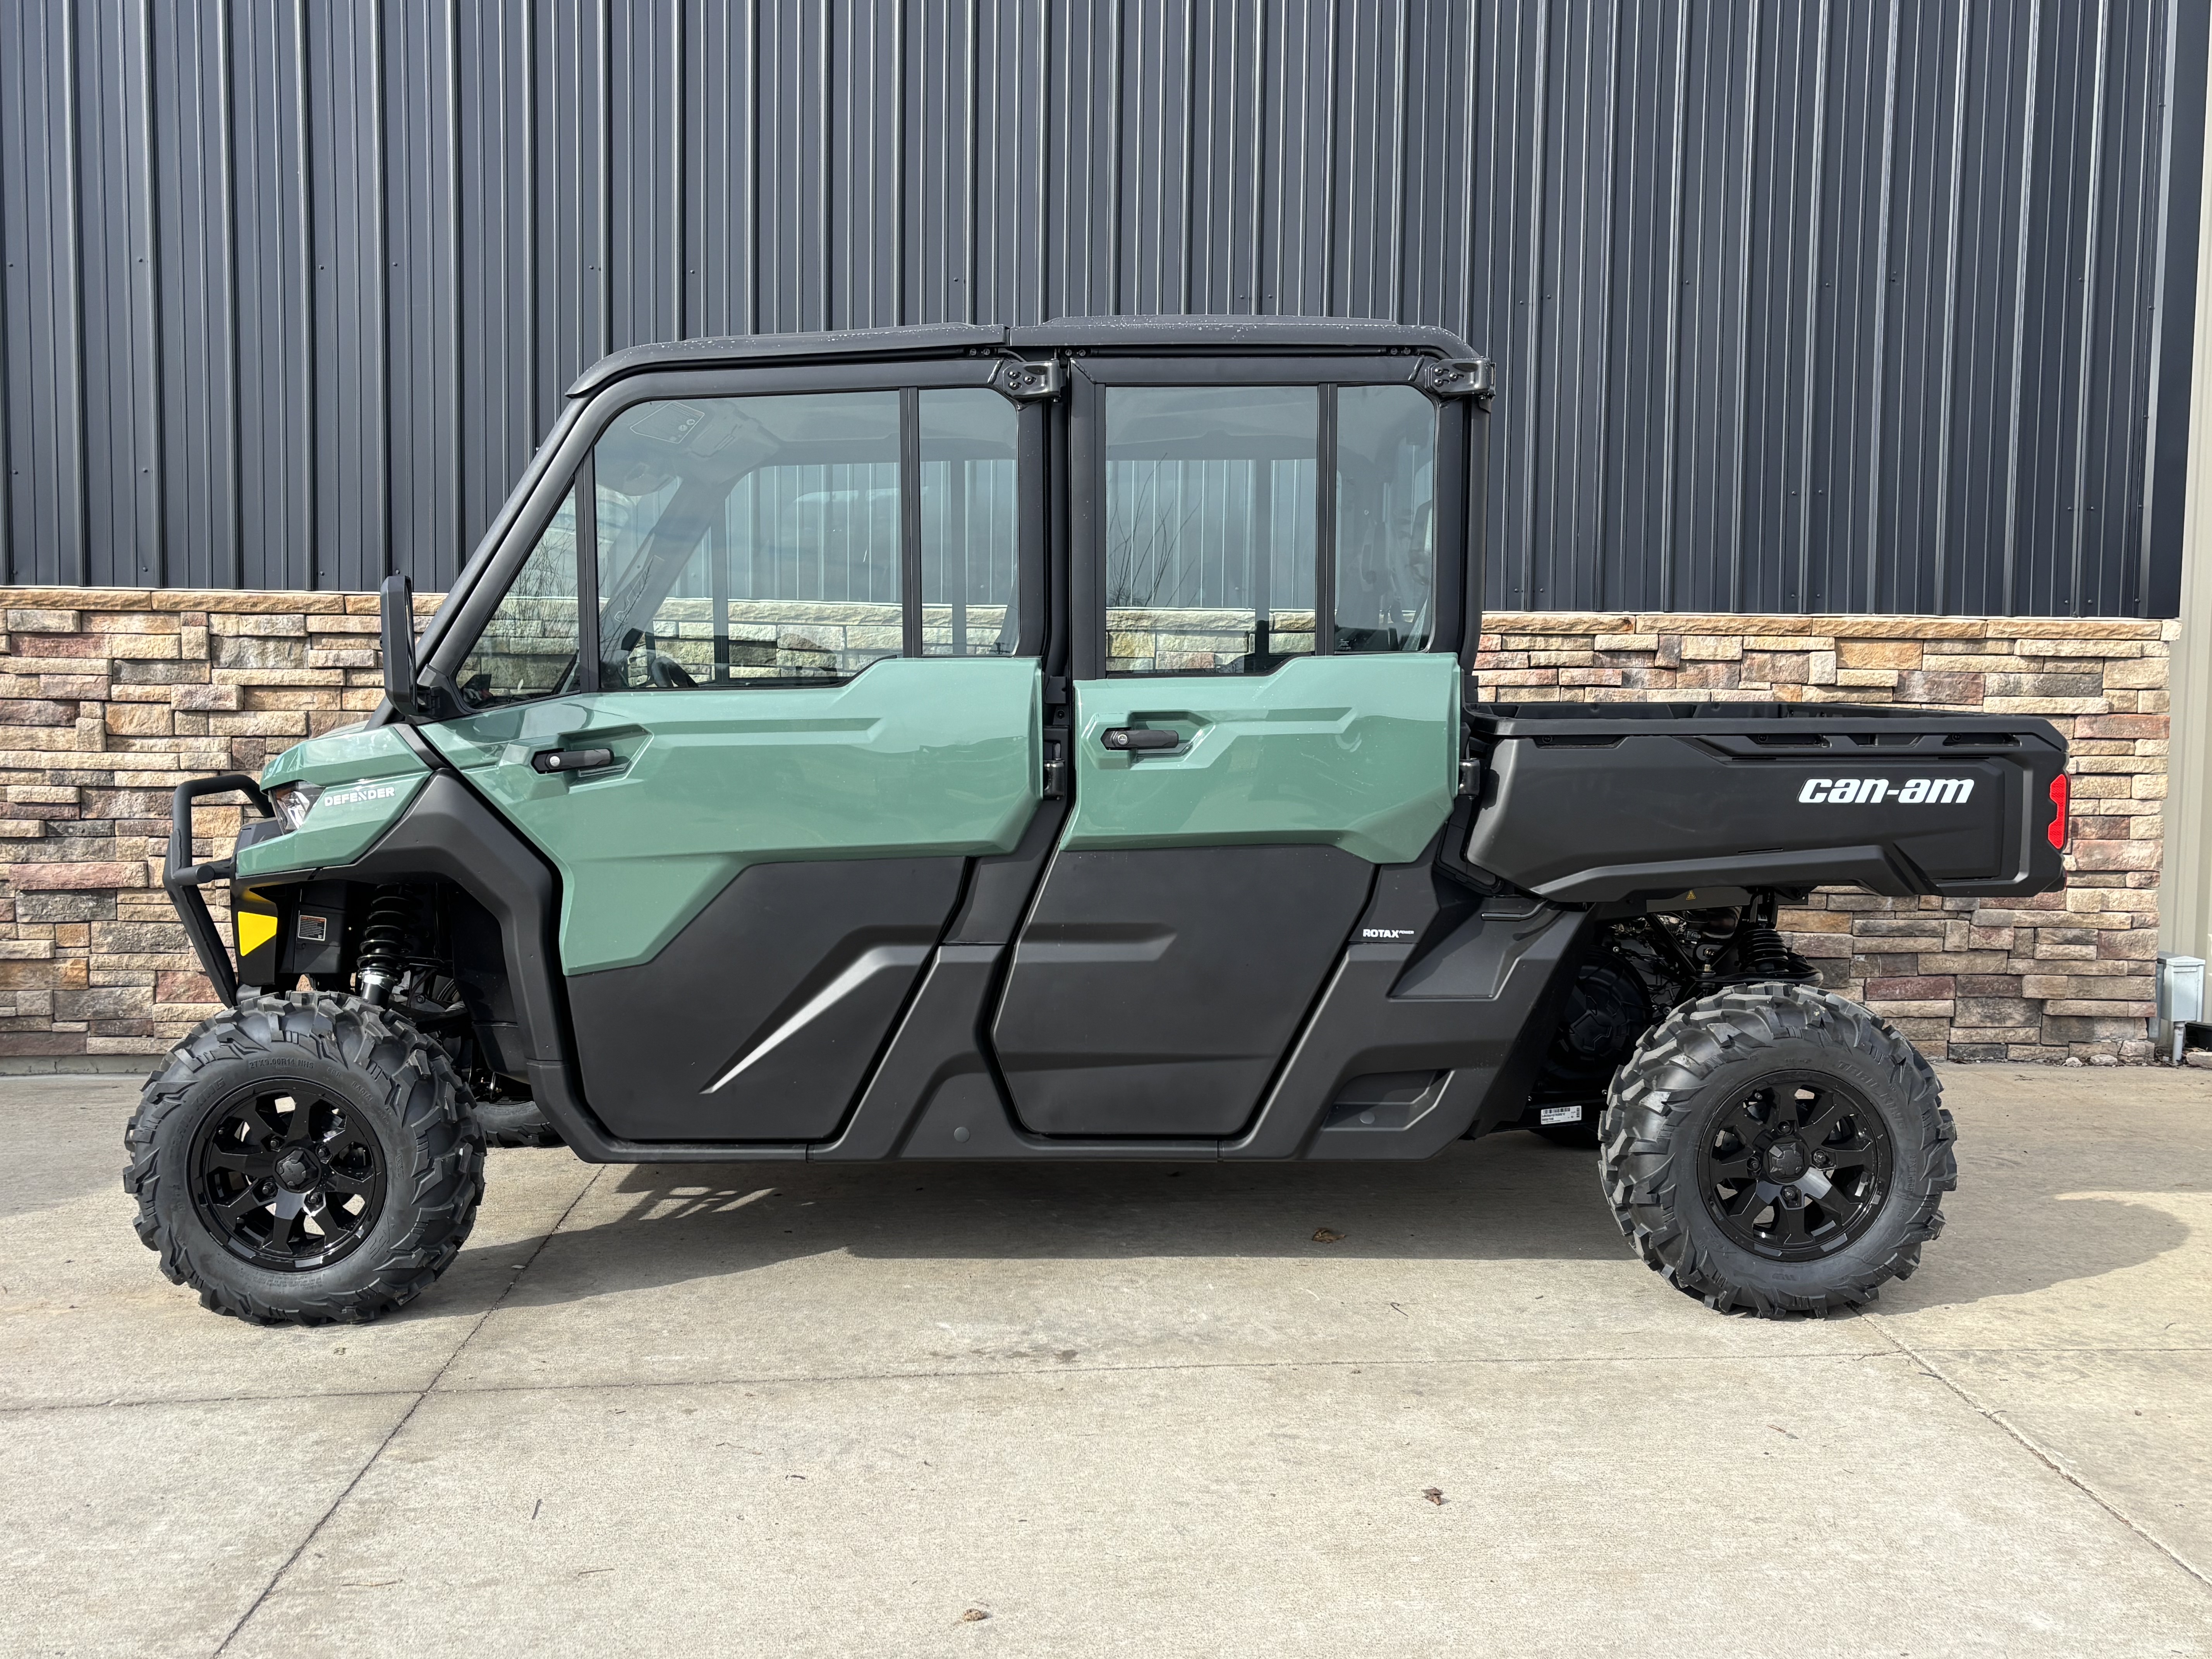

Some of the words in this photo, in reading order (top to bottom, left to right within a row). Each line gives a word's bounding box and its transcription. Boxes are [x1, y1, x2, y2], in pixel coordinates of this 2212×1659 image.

[324, 787, 395, 807] DEFENDER
[1798, 778, 1975, 804] can-am
[1363, 929, 1399, 938] ROTAX
[298, 1059, 314, 1069] NHS
